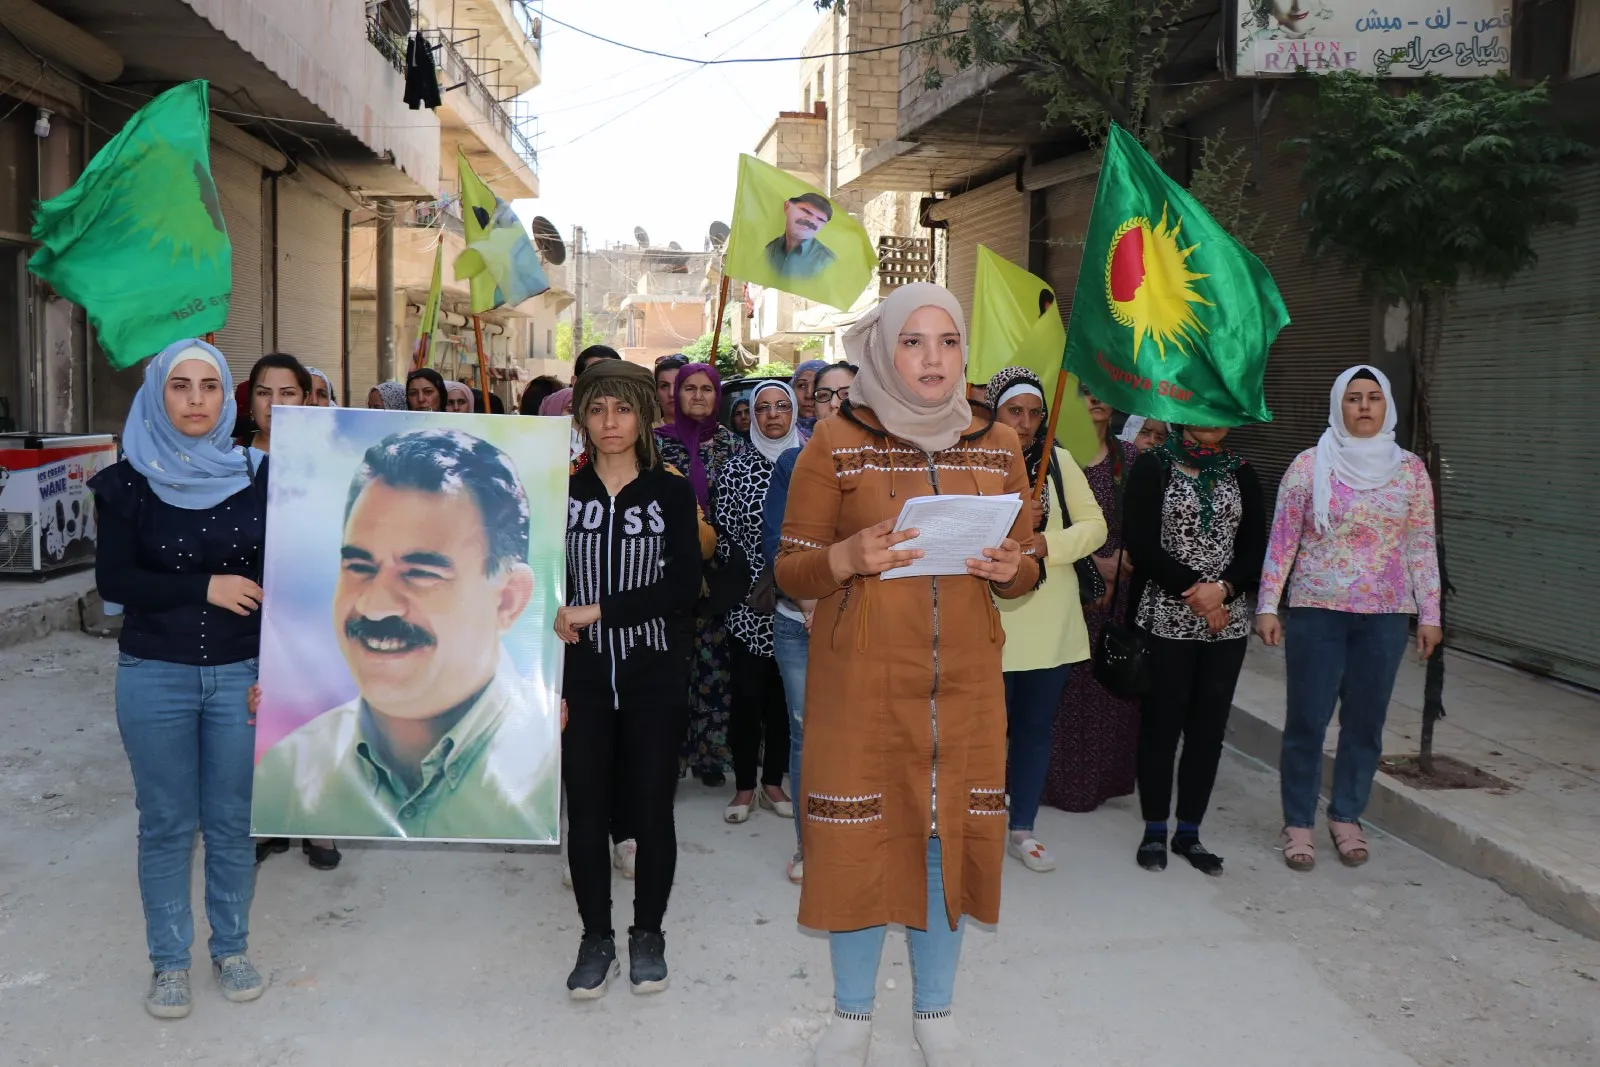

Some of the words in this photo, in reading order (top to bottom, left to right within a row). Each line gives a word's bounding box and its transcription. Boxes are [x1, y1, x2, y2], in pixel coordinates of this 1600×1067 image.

[1355, 8, 1402, 32] ميش
[1425, 6, 1450, 29] لف
[1276, 41, 1342, 53] SALON
[1456, 36, 1510, 67] مكياج
[1265, 51, 1358, 70] RAHAF
[1157, 379, 1194, 402] Star
[37, 471, 47, 482] ICE
